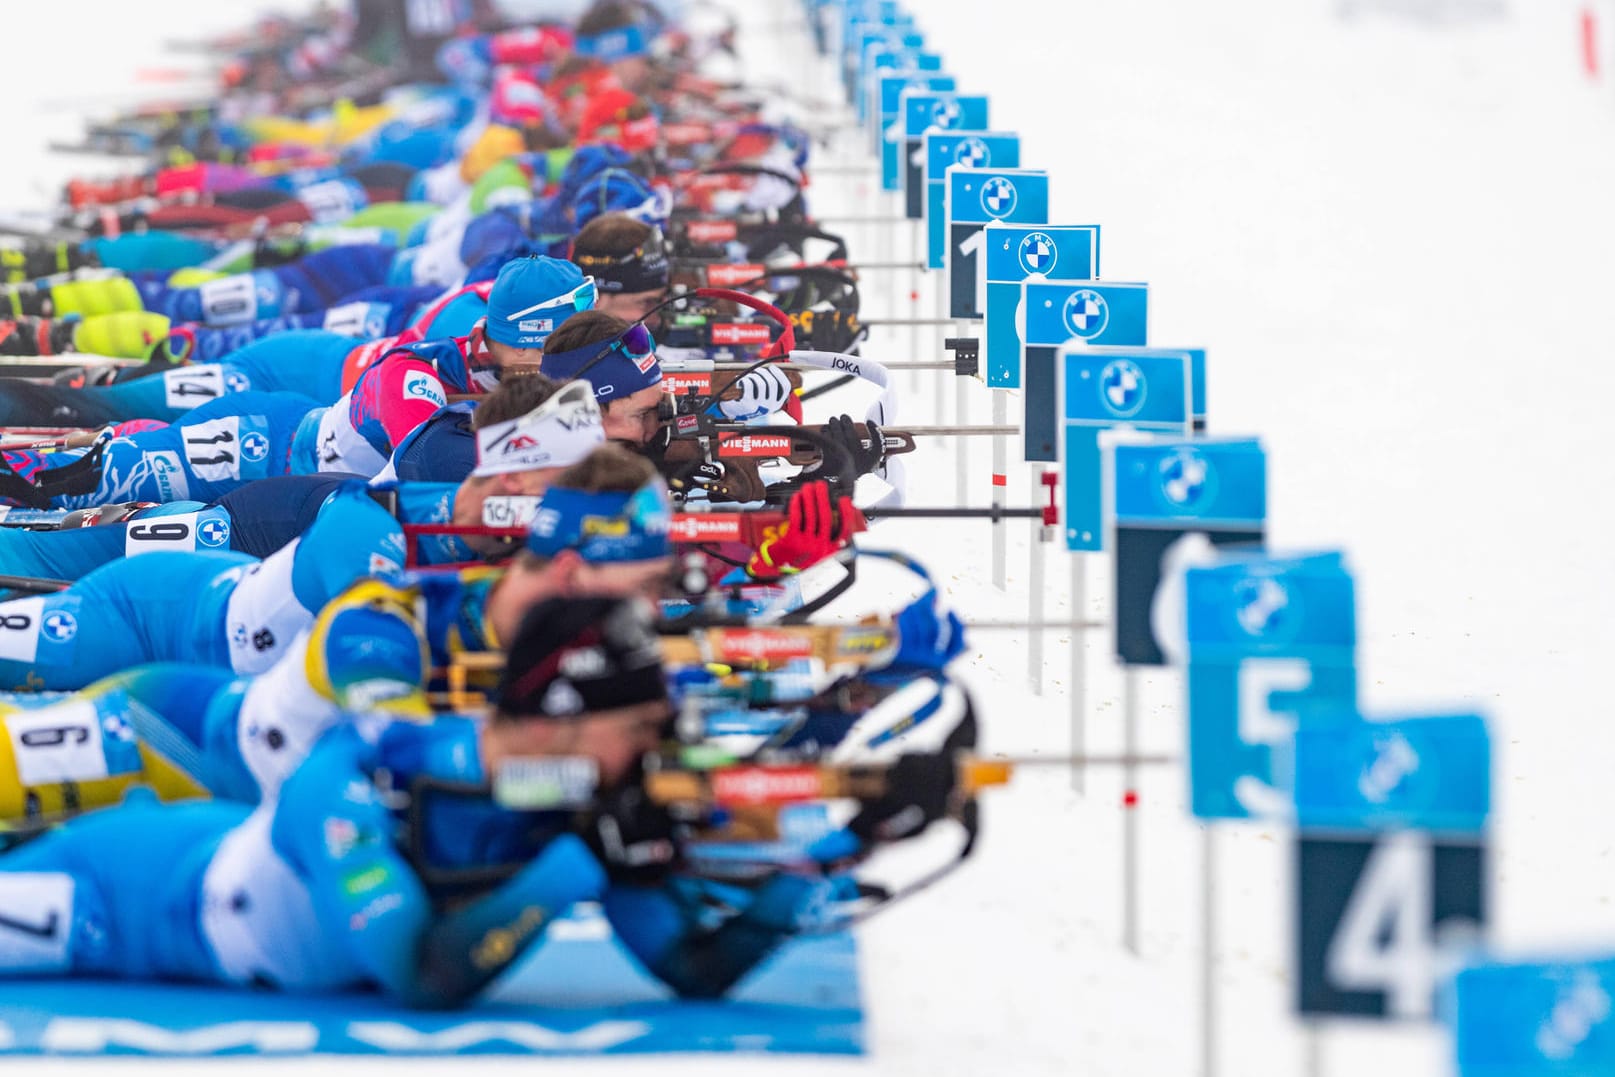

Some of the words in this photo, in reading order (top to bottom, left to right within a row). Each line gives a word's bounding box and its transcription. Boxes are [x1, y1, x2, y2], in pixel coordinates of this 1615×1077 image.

[1023, 234, 1053, 248] BMW
[832, 357, 861, 375] JOKA
[169, 371, 218, 397] 14
[661, 377, 710, 392] ESSMANN
[187, 430, 235, 464] 11
[721, 435, 790, 453] VIESSMANN
[129, 523, 190, 541] 9
[0, 614, 32, 632] 8
[252, 626, 276, 652] 8
[20, 725, 90, 747] 6
[1233, 655, 1312, 818] 5
[0, 907, 59, 941] 7
[1325, 826, 1436, 1018] 4
